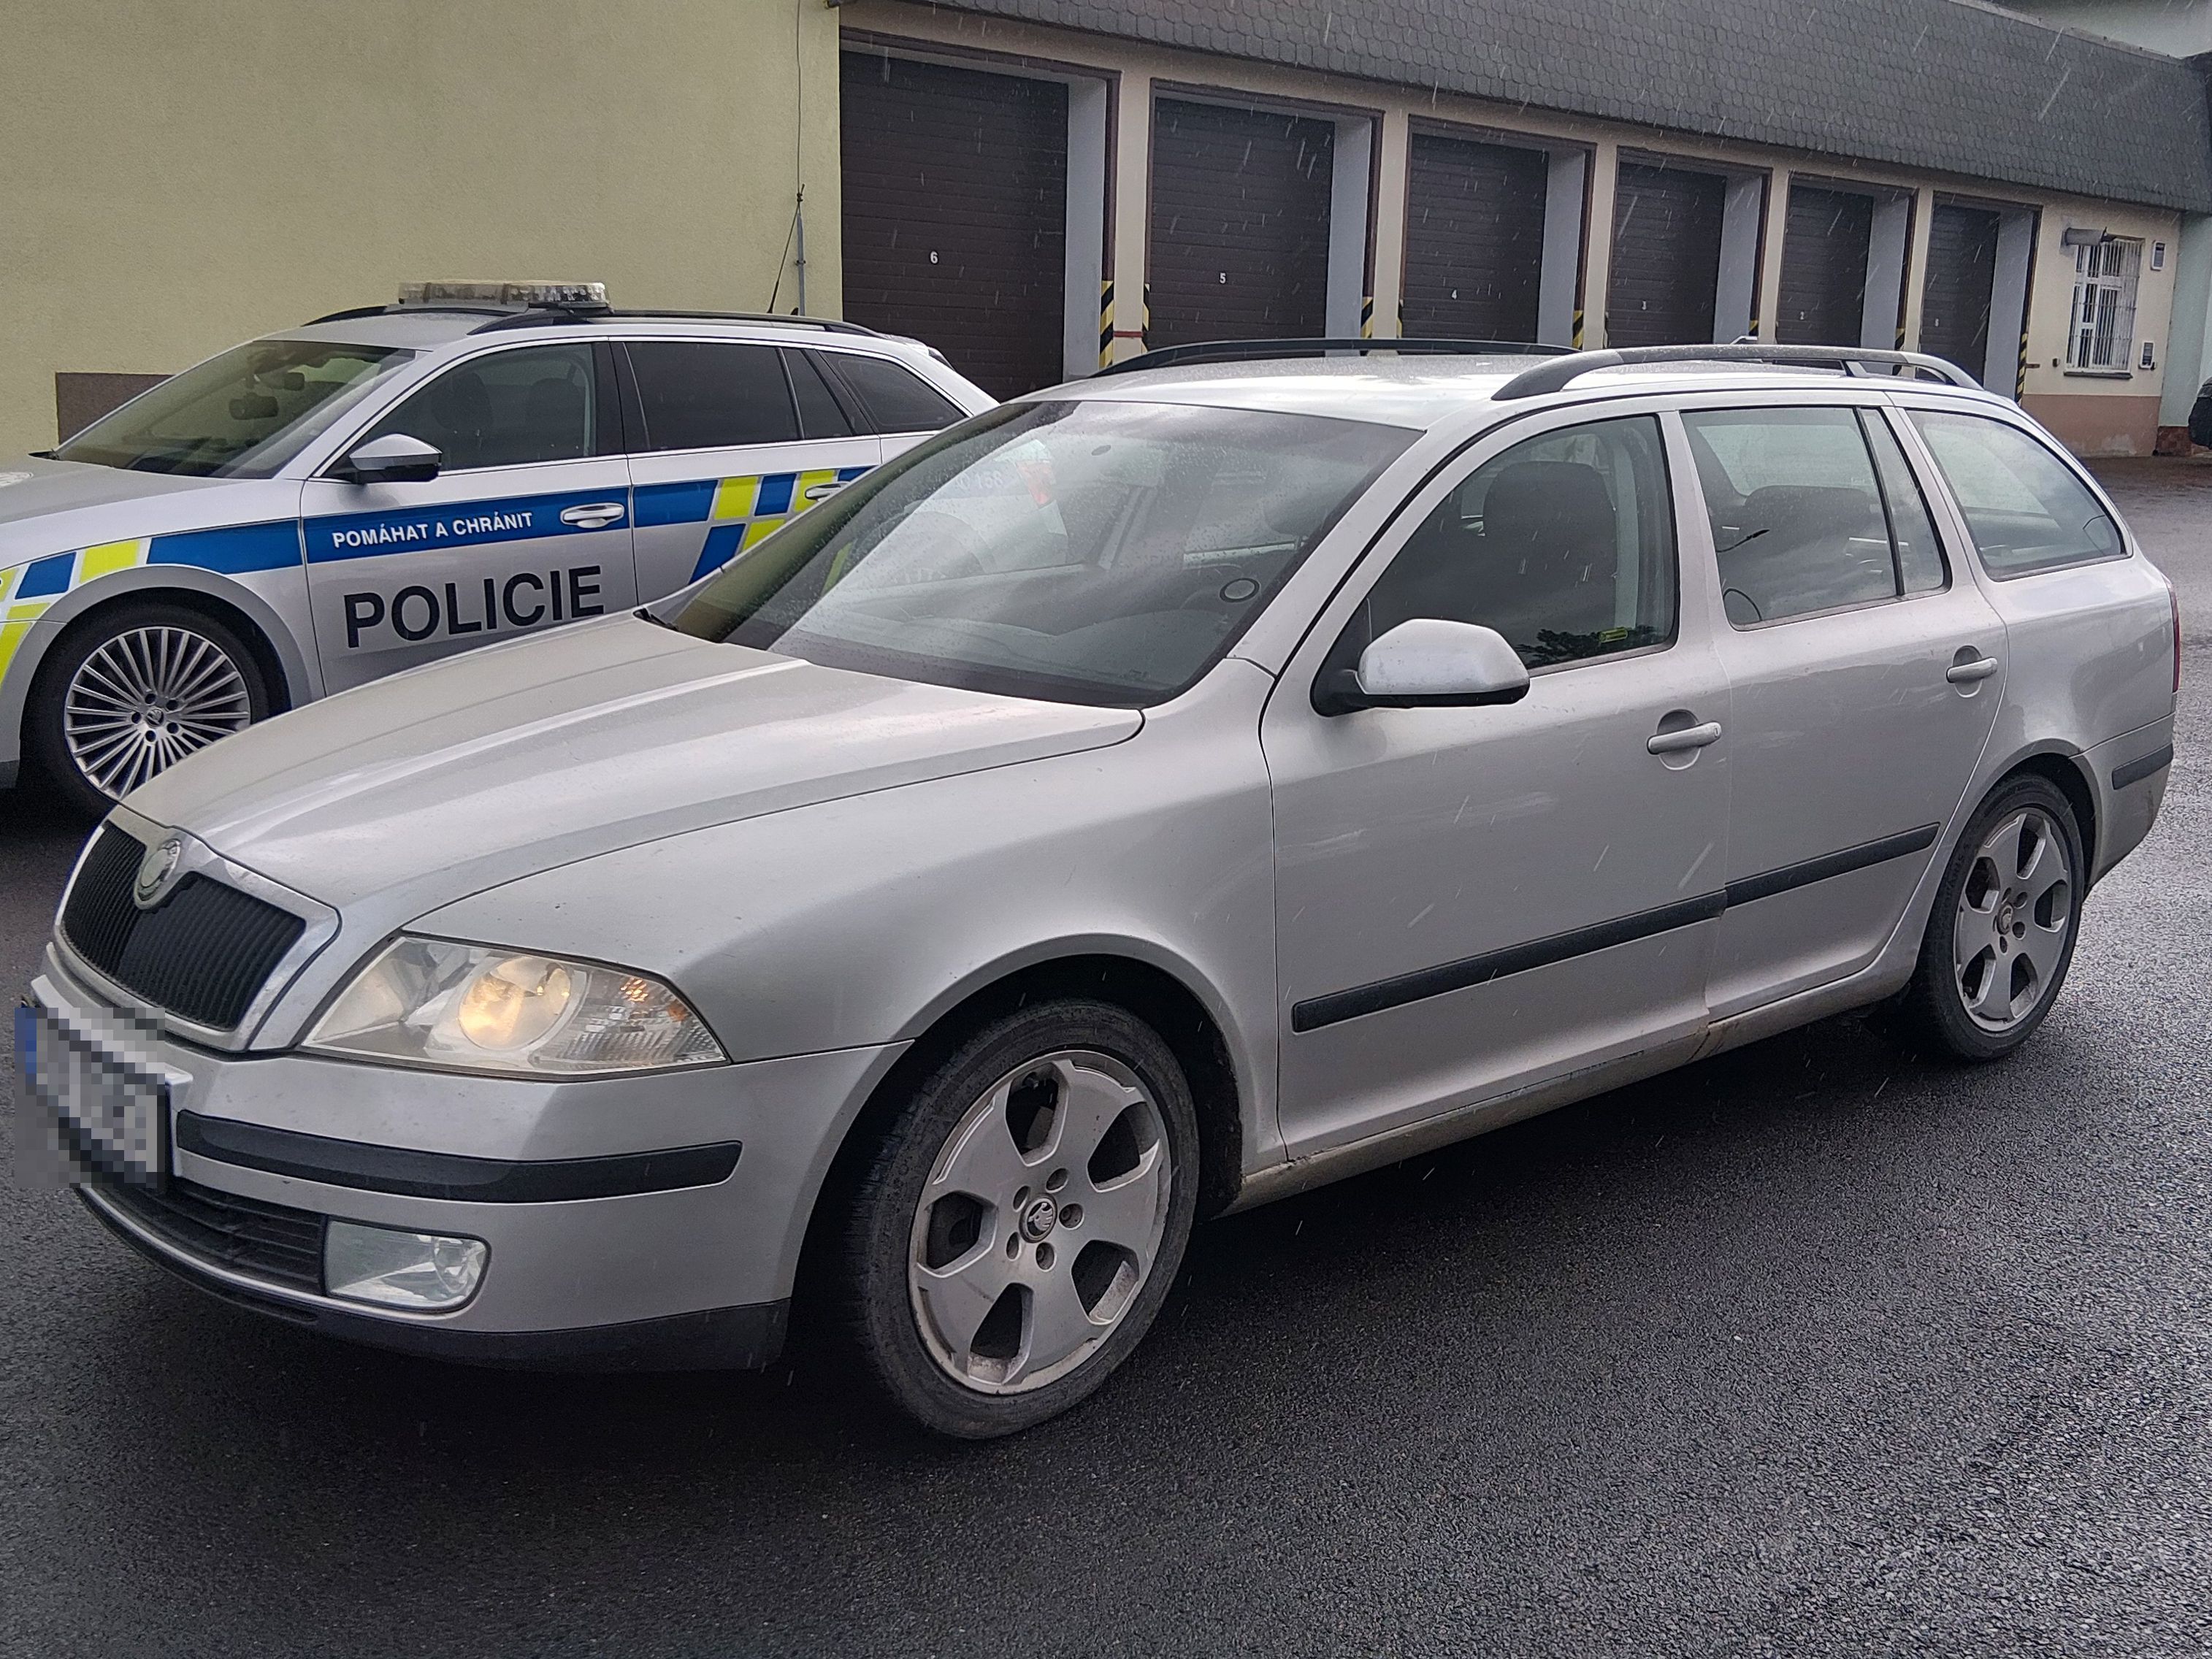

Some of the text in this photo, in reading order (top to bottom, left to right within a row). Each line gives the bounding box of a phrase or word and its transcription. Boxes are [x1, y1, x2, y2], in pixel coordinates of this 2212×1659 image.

[930, 250, 938, 264] 6
[1219, 272, 1226, 284] 5
[1451, 289, 1458, 300] 4
[975, 470, 1003, 489] 158
[332, 511, 532, 548] POMÁHAT A CHRÁNIT
[343, 564, 605, 649] POLICIE
